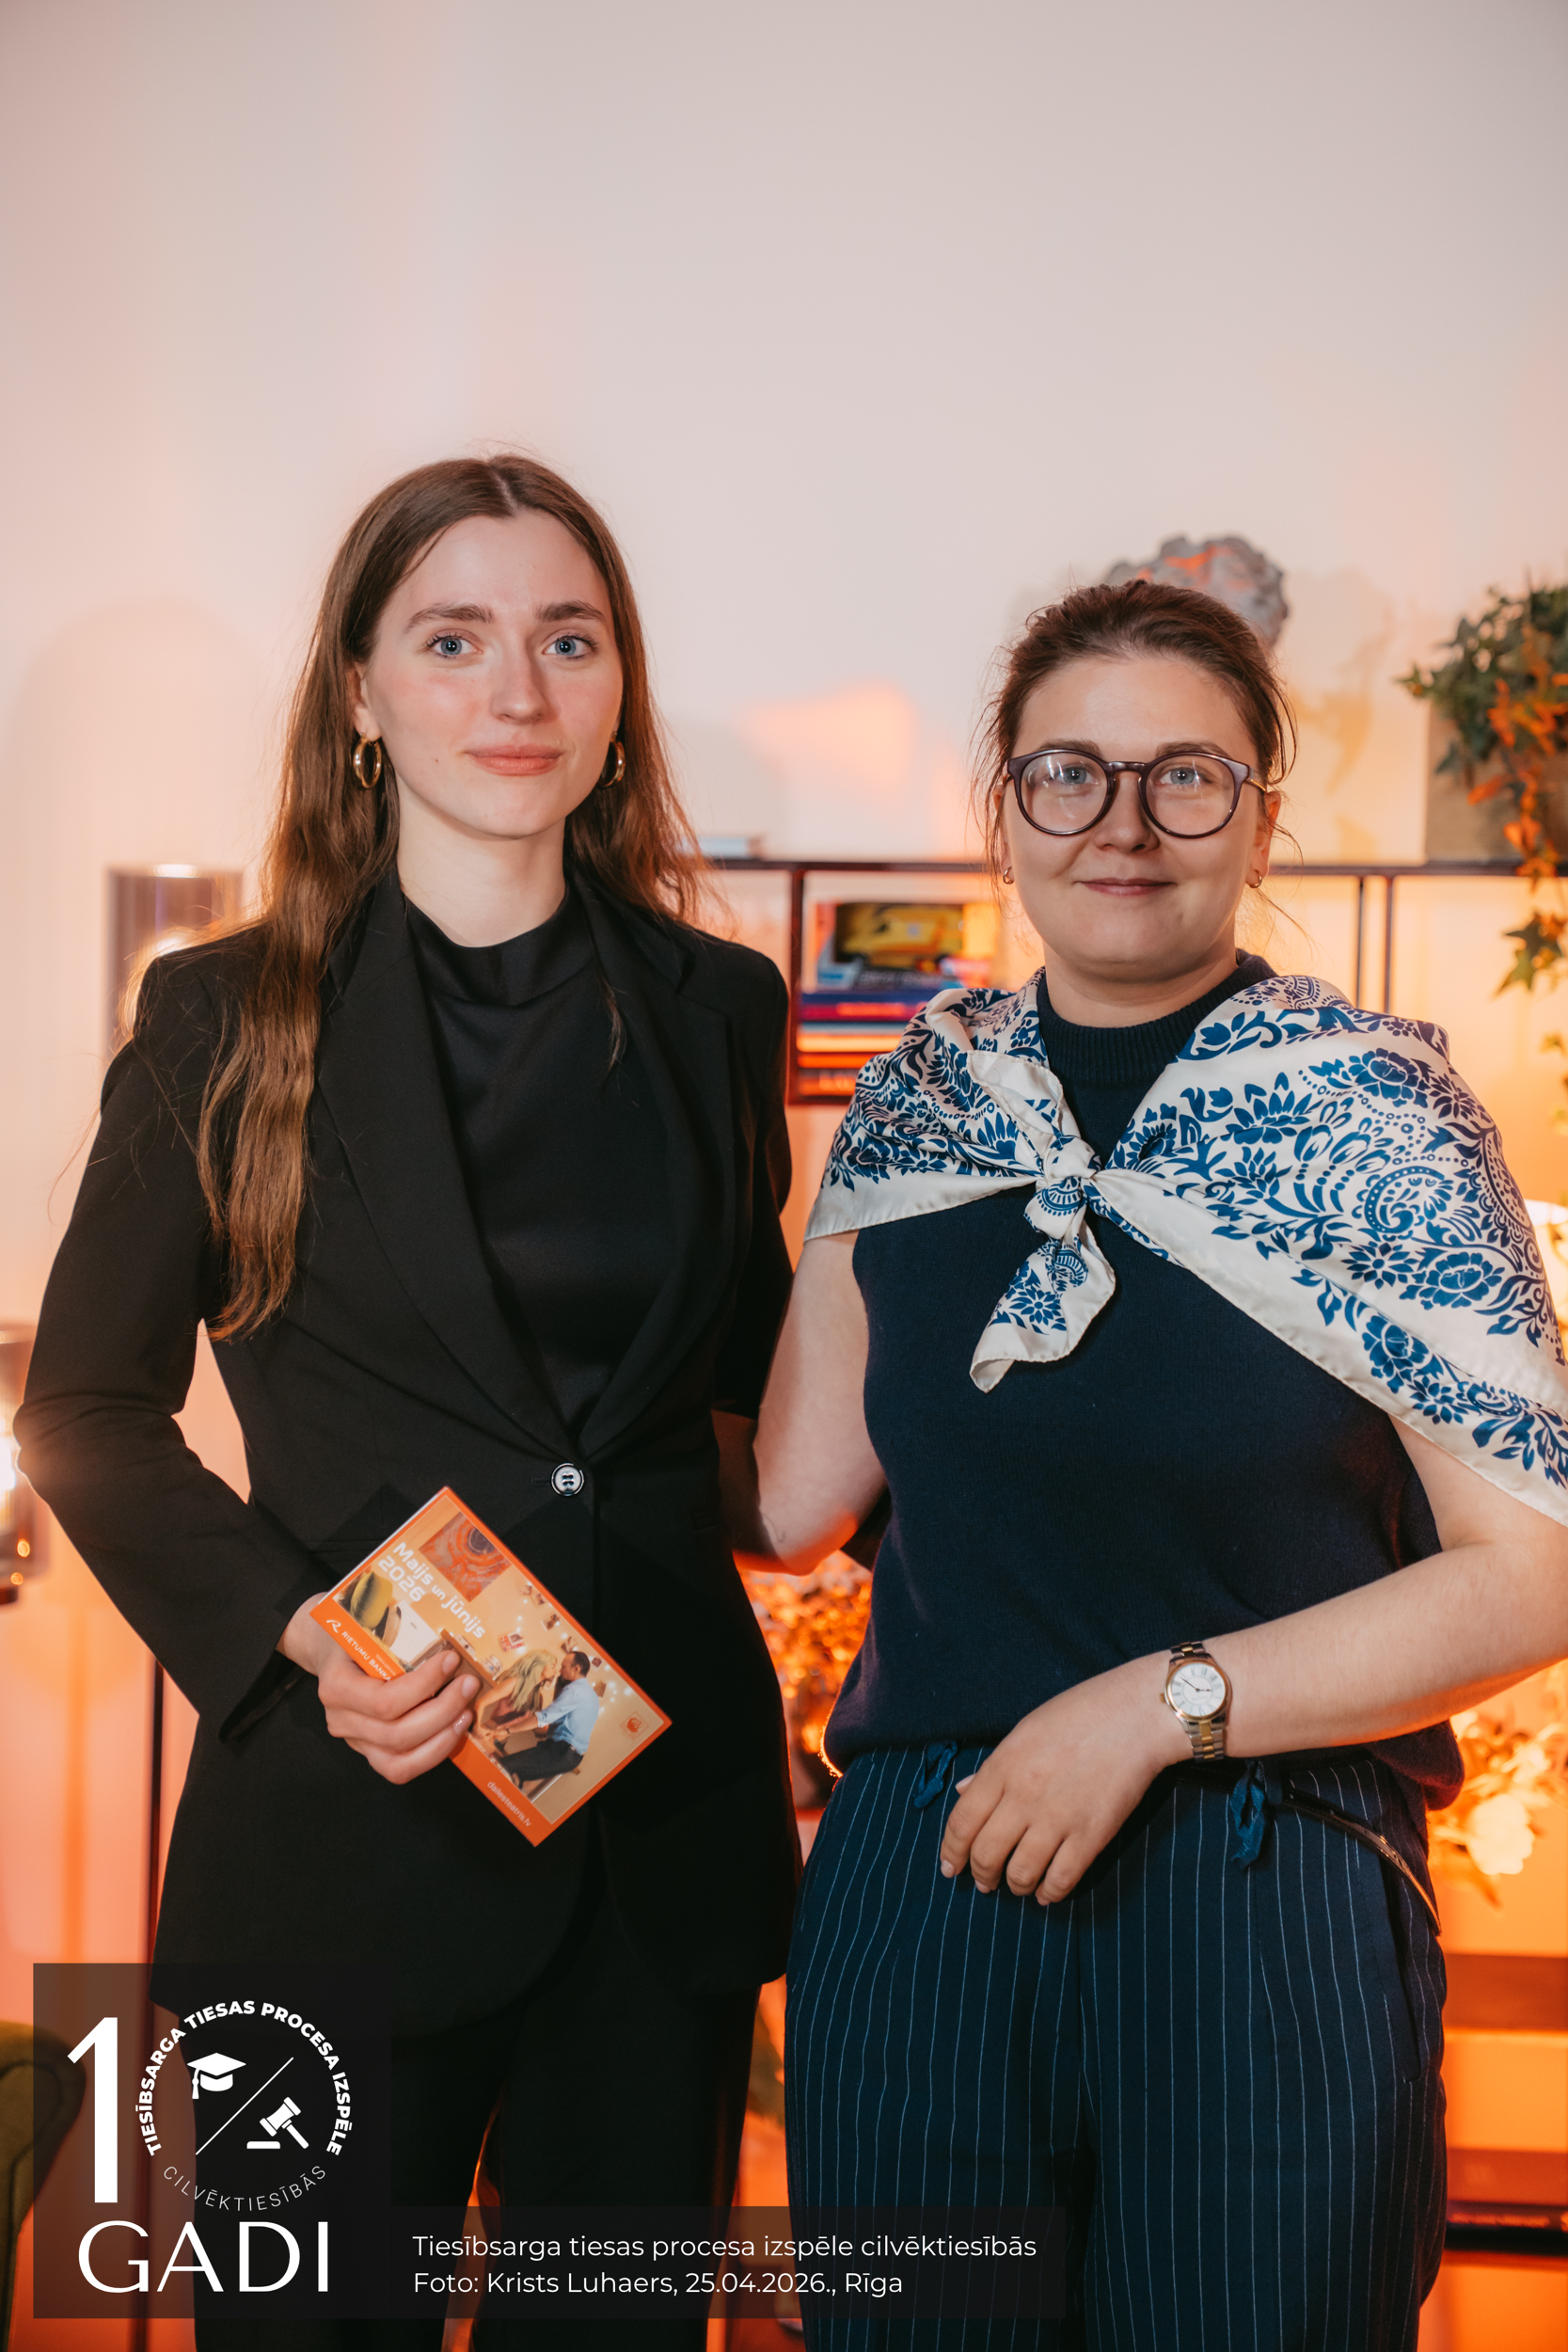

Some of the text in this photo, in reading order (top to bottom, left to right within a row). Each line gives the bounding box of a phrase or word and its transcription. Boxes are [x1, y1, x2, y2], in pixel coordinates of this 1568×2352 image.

[377, 1555, 426, 1602] 2026
[392, 1541, 485, 1639] Maijs un jūnijs
[341, 1630, 391, 1682] RIETUMU BANKA
[487, 1781, 531, 1826] dailesteatris.lv
